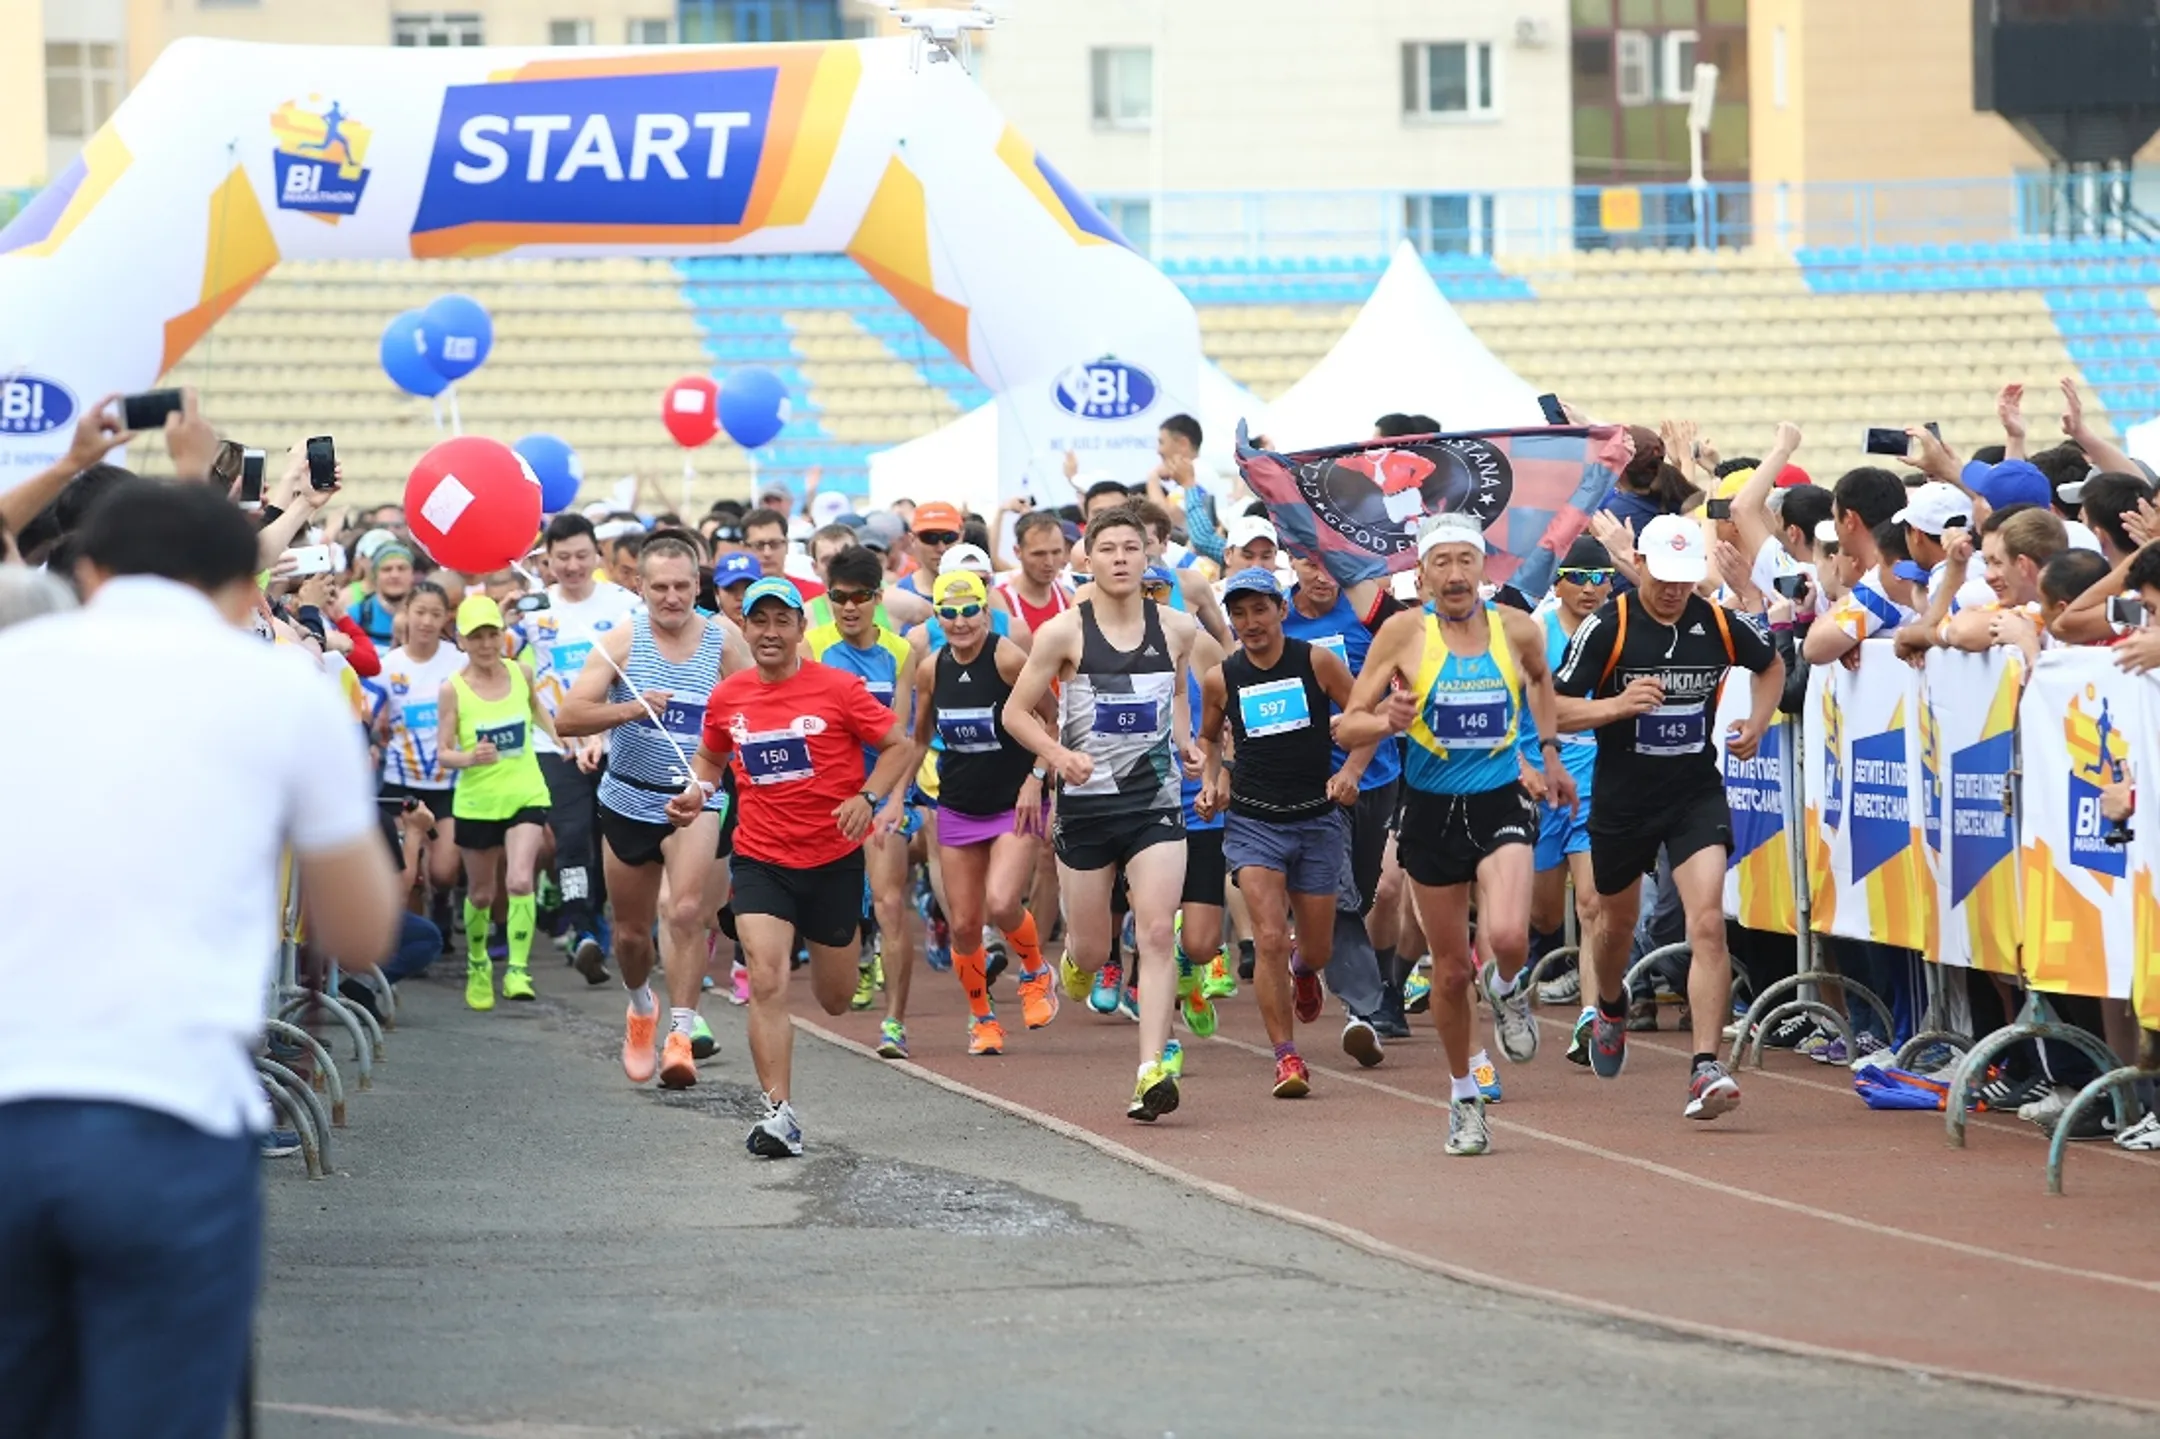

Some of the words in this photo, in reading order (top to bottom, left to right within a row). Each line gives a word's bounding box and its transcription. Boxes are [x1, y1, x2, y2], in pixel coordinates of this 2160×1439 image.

[453, 112, 751, 184] START
[284, 164, 323, 192] BI
[1258, 699, 1287, 718] 597
[1117, 712, 1137, 726] 63
[1457, 712, 1488, 729] 146
[1657, 722, 1687, 738] 143
[760, 748, 789, 765] 150
[2075, 797, 2100, 837] BI
